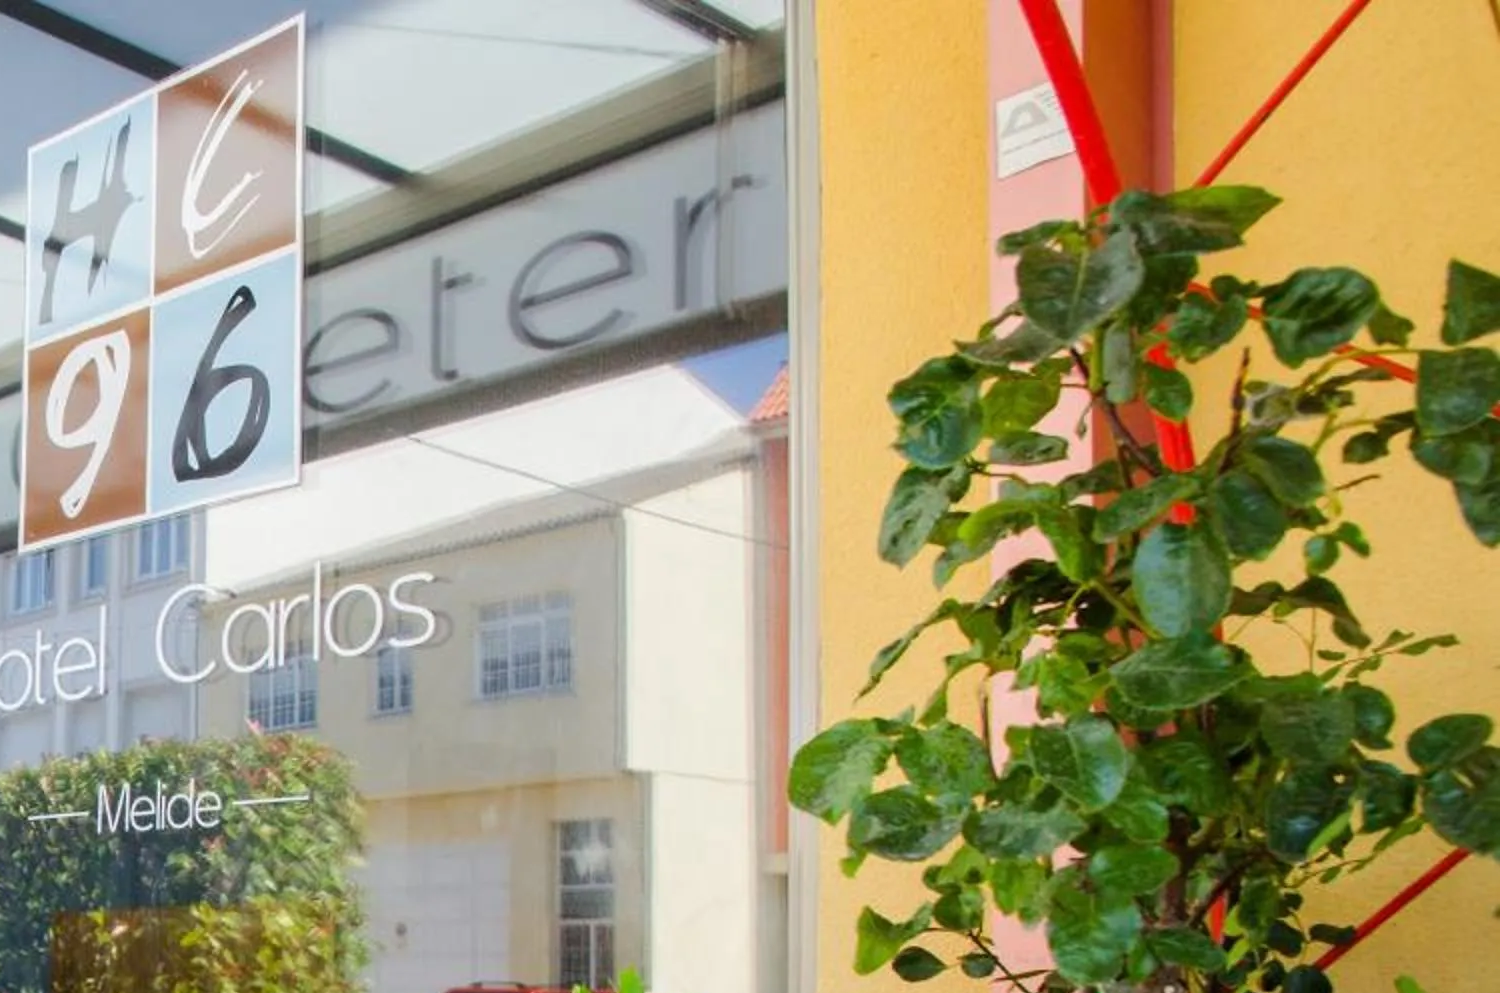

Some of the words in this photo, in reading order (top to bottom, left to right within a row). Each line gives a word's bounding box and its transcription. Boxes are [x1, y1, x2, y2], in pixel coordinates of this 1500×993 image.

[45, 286, 271, 519] 96
[155, 560, 437, 684] Carlos
[96, 778, 223, 835] Melide
